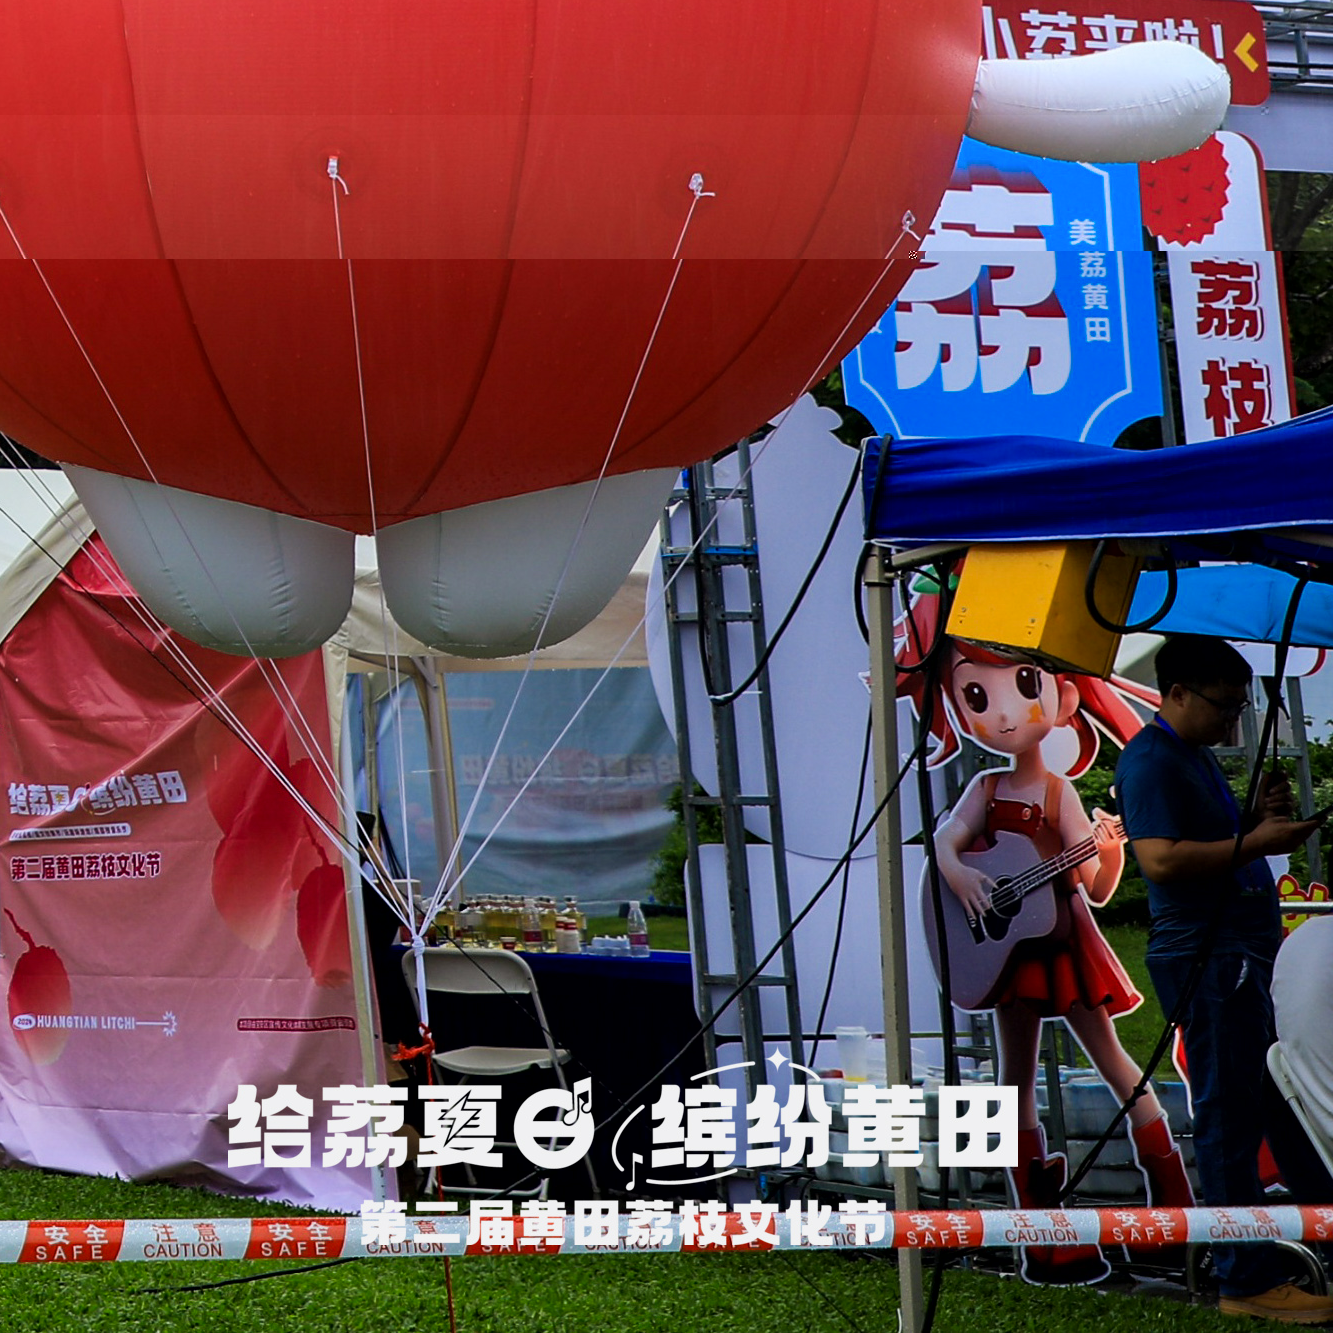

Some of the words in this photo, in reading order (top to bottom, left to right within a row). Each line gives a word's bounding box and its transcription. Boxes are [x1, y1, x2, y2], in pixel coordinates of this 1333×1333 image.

[1068, 218, 1111, 343] 美荔黄田
[1190, 258, 1276, 437] 荔枝
[11, 851, 161, 881] 第二届黄田荔枝文化节
[37, 1015, 98, 1029] HUANGTIAN
[101, 1017, 135, 1029] LITCHI
[44, 1224, 109, 1245] 安全
[152, 1222, 220, 1243] 注意
[268, 1221, 333, 1242] 安全
[909, 1214, 971, 1232] 安全
[1115, 1210, 1176, 1228] 安全
[36, 1245, 103, 1261] SAFE
[143, 1243, 222, 1259] CAUTION
[261, 1241, 328, 1257] SAFE
[906, 1230, 969, 1246] SAFE
[1005, 1228, 1079, 1243] CAUTION
[1112, 1226, 1175, 1242] SAFE
[1209, 1224, 1282, 1239] CAUTION
